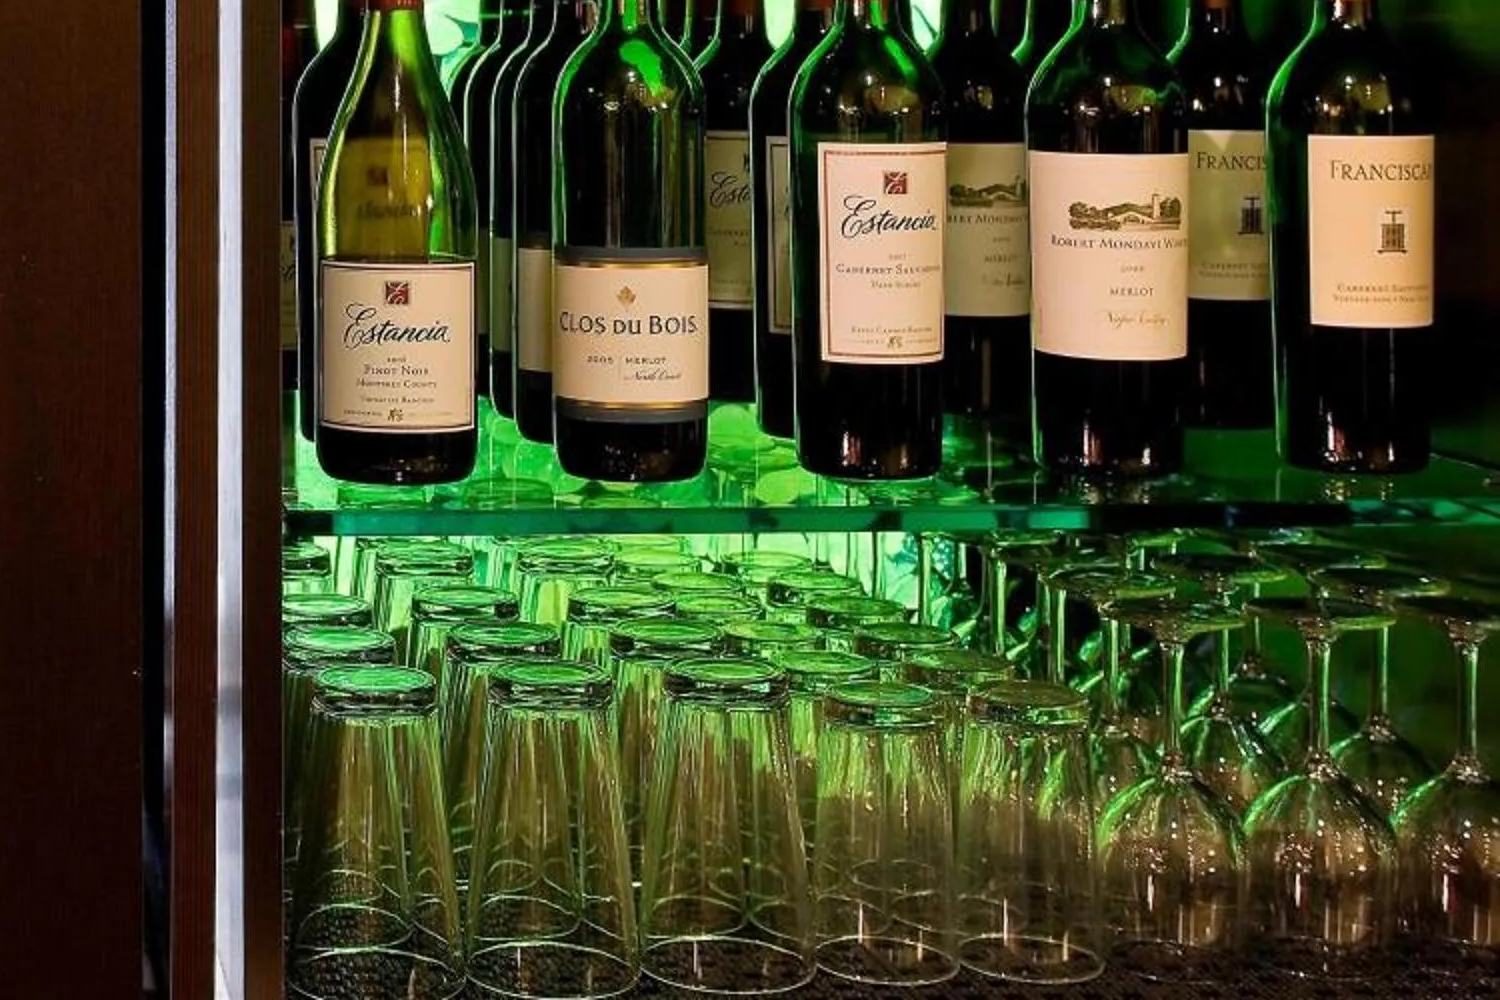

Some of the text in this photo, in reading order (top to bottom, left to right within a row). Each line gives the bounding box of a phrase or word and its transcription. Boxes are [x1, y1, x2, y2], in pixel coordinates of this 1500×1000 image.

[1197, 151, 1267, 171] FRANCIS
[1330, 159, 1431, 181] FRANCISCA
[709, 171, 750, 208] Esta
[841, 195, 938, 239] Estancia
[1051, 234, 1095, 249] ROBERT
[1100, 237, 1162, 249] MONDAVI
[836, 263, 893, 274] CABERNET
[1109, 286, 1155, 298] MERLOT
[343, 302, 450, 350] Estancia
[559, 312, 698, 335] CLOS DU BOIS
[363, 363, 429, 376] PINOT NOIR
[625, 356, 667, 365] MERLOT
